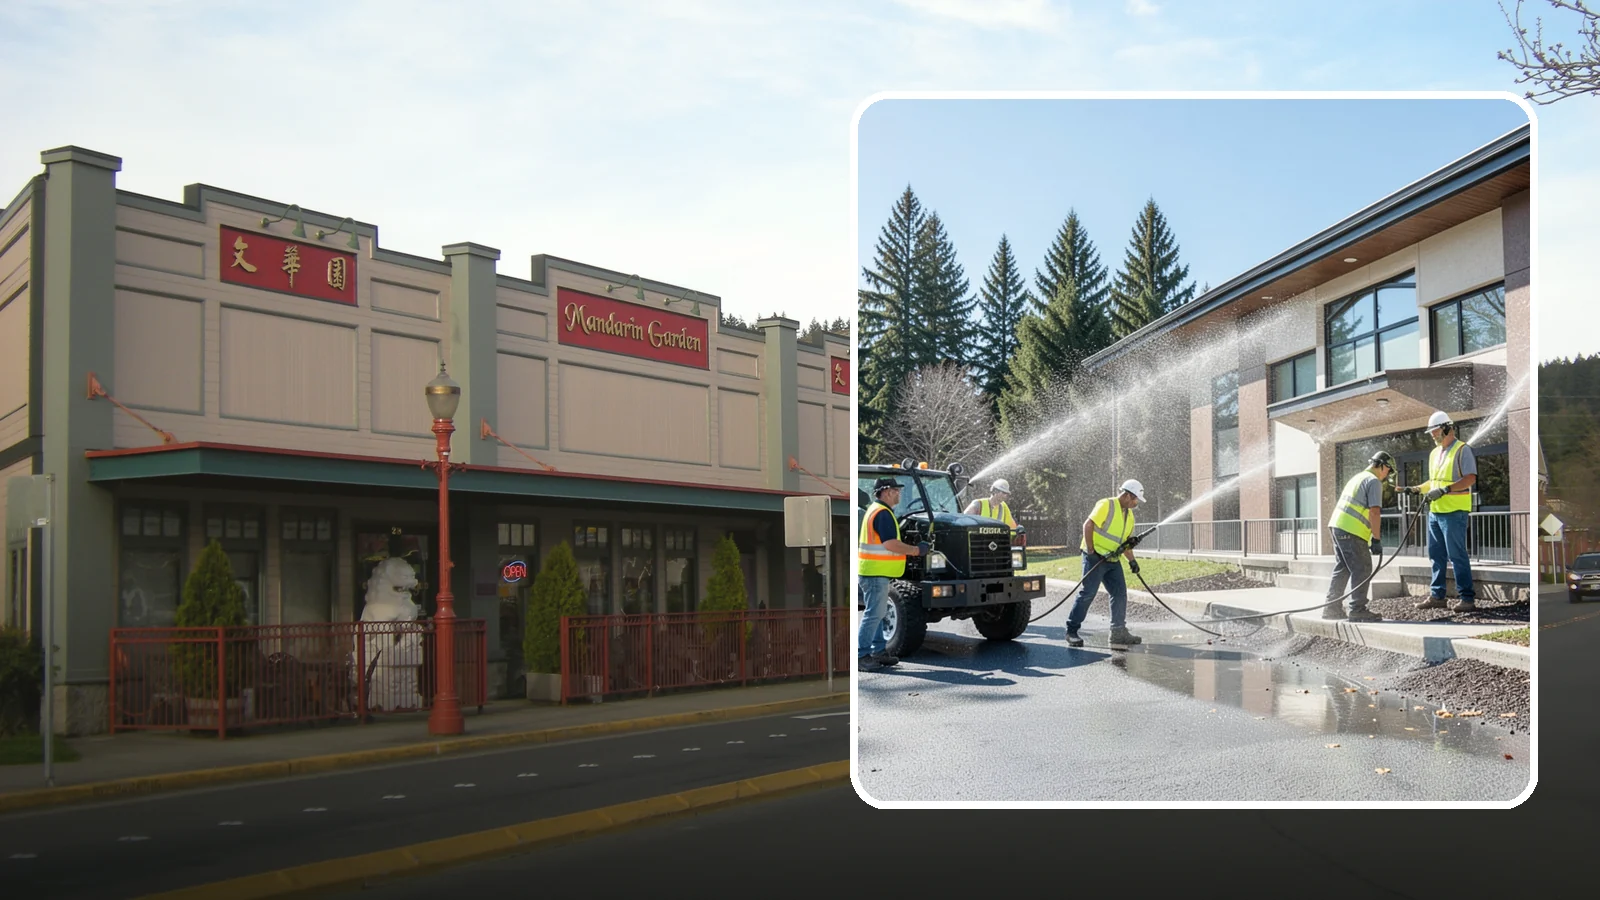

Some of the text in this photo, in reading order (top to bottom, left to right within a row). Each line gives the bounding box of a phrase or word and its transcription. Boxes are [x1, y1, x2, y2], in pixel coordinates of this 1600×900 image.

[564, 302, 701, 352] Mandarin Garden
[503, 565, 527, 578] OPEN
